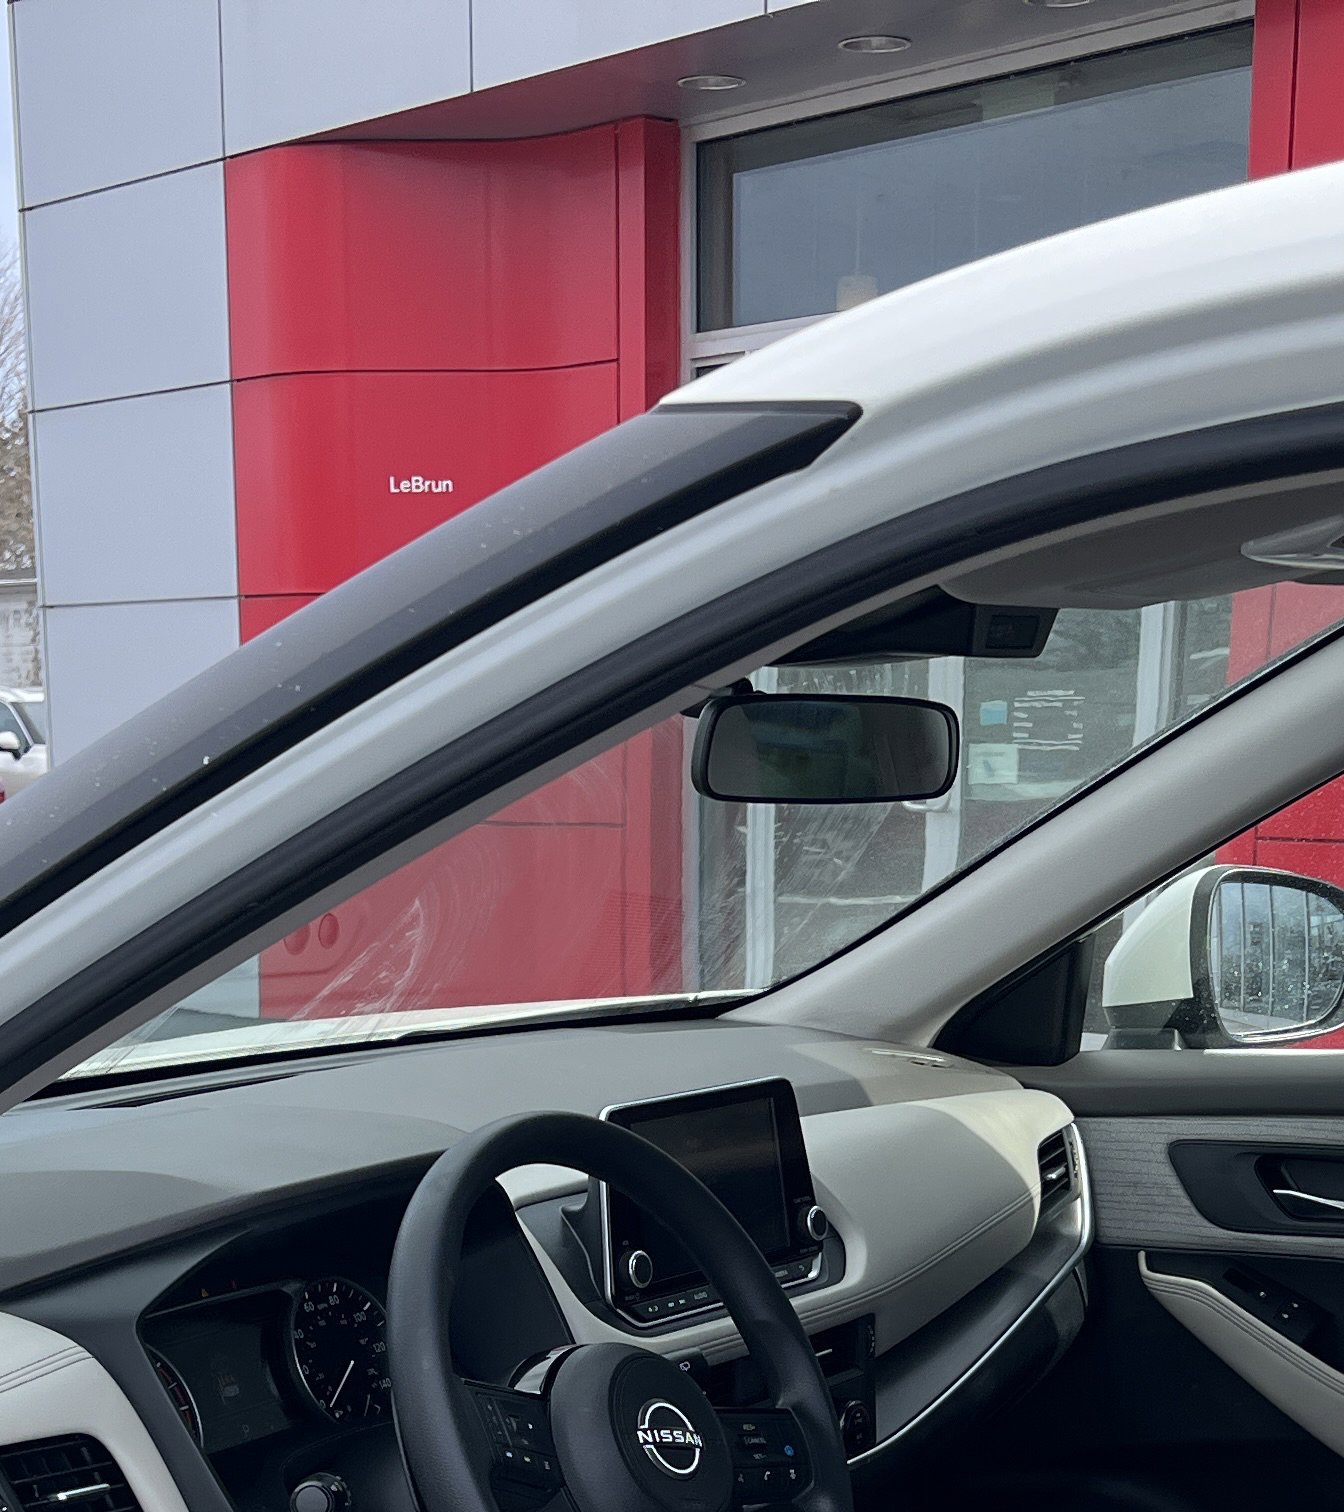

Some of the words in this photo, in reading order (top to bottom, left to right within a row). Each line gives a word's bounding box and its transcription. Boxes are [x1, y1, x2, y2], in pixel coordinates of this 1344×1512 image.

[389, 475, 454, 493] LeBrun
[328, 1294, 340, 1306] 80
[303, 1301, 314, 1313] 60
[352, 1311, 367, 1323] 100
[372, 1341, 386, 1353] 120
[378, 1377, 392, 1390] 140
[636, 1429, 703, 1448] NISSAN
